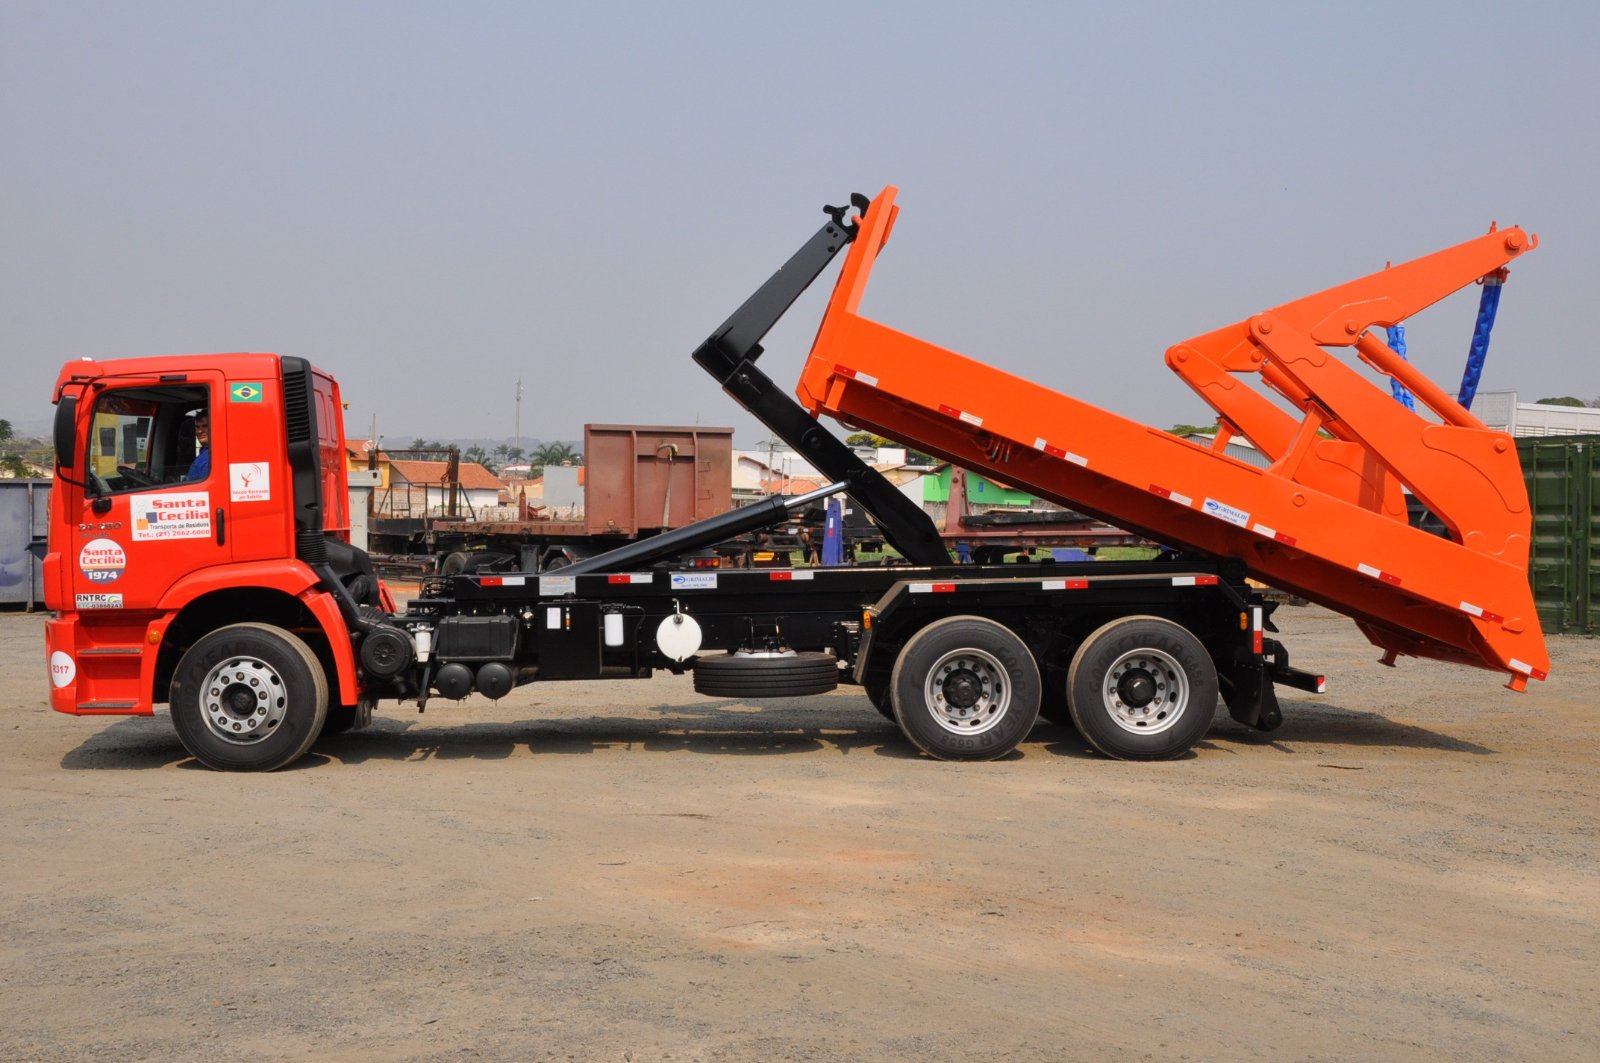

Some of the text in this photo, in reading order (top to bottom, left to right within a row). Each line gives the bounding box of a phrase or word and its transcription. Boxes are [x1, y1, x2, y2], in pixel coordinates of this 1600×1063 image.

[152, 499, 206, 509] Santa
[83, 548, 122, 556] Santa
[87, 571, 118, 580] 1974
[76, 594, 107, 602] RNTRC
